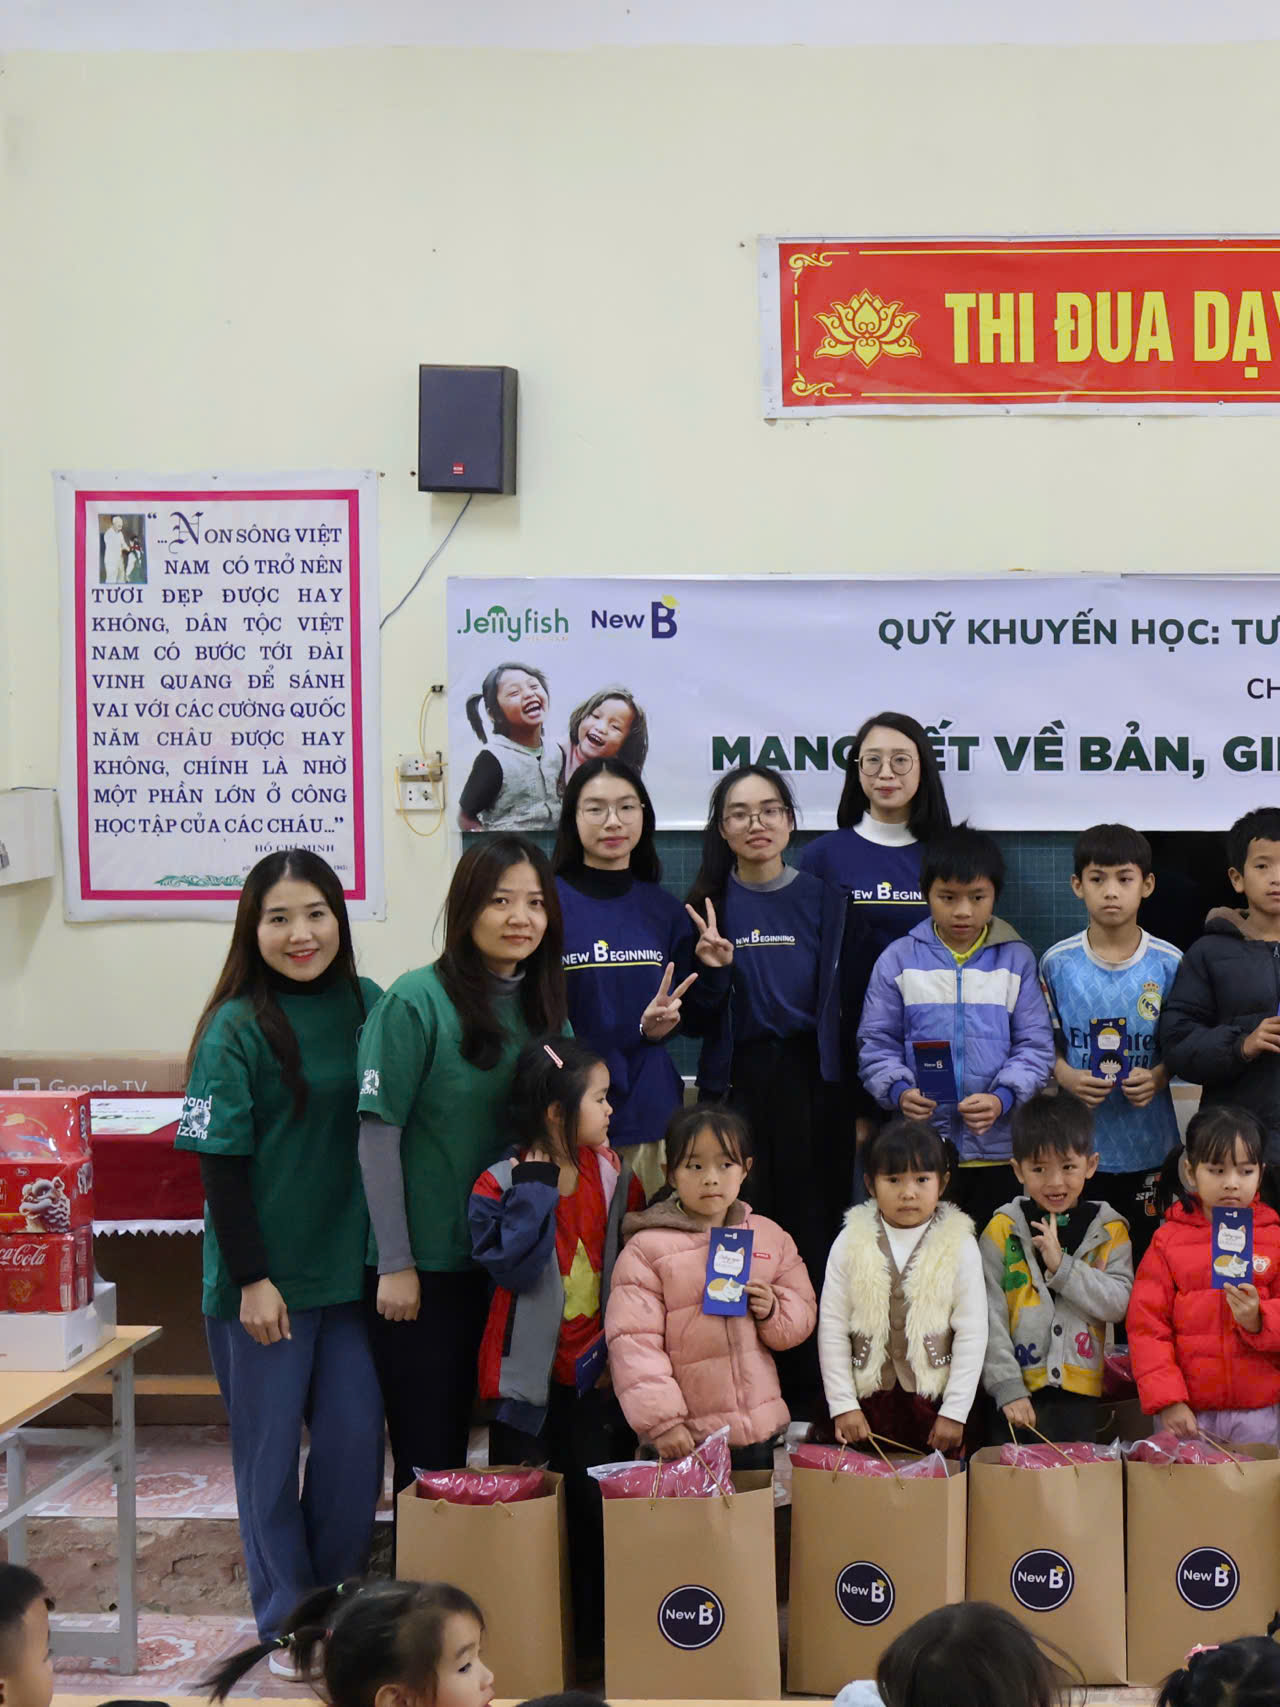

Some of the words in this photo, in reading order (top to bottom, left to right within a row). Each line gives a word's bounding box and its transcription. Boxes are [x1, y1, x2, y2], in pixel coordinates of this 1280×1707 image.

[944, 292, 1035, 364] THI
[1054, 291, 1174, 363] ĐUA
[235, 523, 291, 544] SÔNG
[294, 523, 343, 547] VIỆT
[164, 559, 210, 575] NAM
[222, 554, 250, 575] CÓ
[254, 552, 295, 575] TRỞ
[300, 554, 343, 574] NÊN
[91, 586, 143, 604] TƯƠI
[161, 588, 204, 608] ĐẸP
[221, 586, 280, 607] ĐƯỢC
[297, 587, 343, 603] HAY
[91, 612, 170, 634] KHÔNG,
[185, 612, 228, 632] DÂN
[243, 612, 282, 636] TỘC
[297, 611, 344, 636] VIỆT
[591, 610, 645, 629] New
[651, 601, 679, 639] B
[878, 611, 956, 651] QUỸ
[968, 607, 1117, 645] KHUYẾN
[1131, 618, 1220, 653] HỌC:
[91, 645, 140, 661] NAM
[153, 641, 181, 661] CÓ
[194, 640, 246, 661] BƯỚC
[259, 640, 293, 661] TỚI
[308, 640, 344, 661] ĐÀI
[91, 674, 145, 689] VINH
[160, 674, 233, 691] QUANG
[247, 664, 275, 689] ĐỂ
[289, 669, 345, 689] SÁNH
[92, 702, 129, 718] VAI
[134, 698, 170, 718] VỚI
[175, 698, 214, 718] CÁC
[218, 697, 286, 718] CƯỜNG
[289, 695, 346, 719] QUỐC
[92, 727, 140, 747] NĂM
[156, 726, 213, 747] CHÂU
[231, 729, 285, 750] ĐƯỢC
[301, 731, 346, 746] HAY
[993, 719, 1065, 772] VỀ
[1079, 720, 1205, 780] BẢN,
[93, 755, 170, 777] KHÔNG,
[183, 755, 249, 776] CHÍNH
[262, 755, 289, 775] LÀ
[302, 754, 347, 775] NHỜ
[93, 783, 138, 808] MỘT
[147, 780, 204, 804] PHẦN
[214, 783, 256, 804] LỚN
[266, 781, 281, 804] Ở
[291, 783, 348, 804] CÔNG
[94, 818, 136, 838] HỌC
[138, 813, 178, 837] TẬP
[180, 811, 222, 834] CỦA
[224, 813, 264, 834] CÁC
[751, 930, 796, 943] BEGINNING
[593, 941, 664, 962] BEGINNING
[1017, 1570, 1047, 1583] New
[1048, 1568, 1063, 1589] B
[1183, 1569, 1212, 1581] New
[1214, 1566, 1229, 1587] B
[842, 1581, 869, 1597] New
[871, 1581, 885, 1603] B
[665, 1608, 696, 1620] New
[698, 1603, 714, 1626] B
